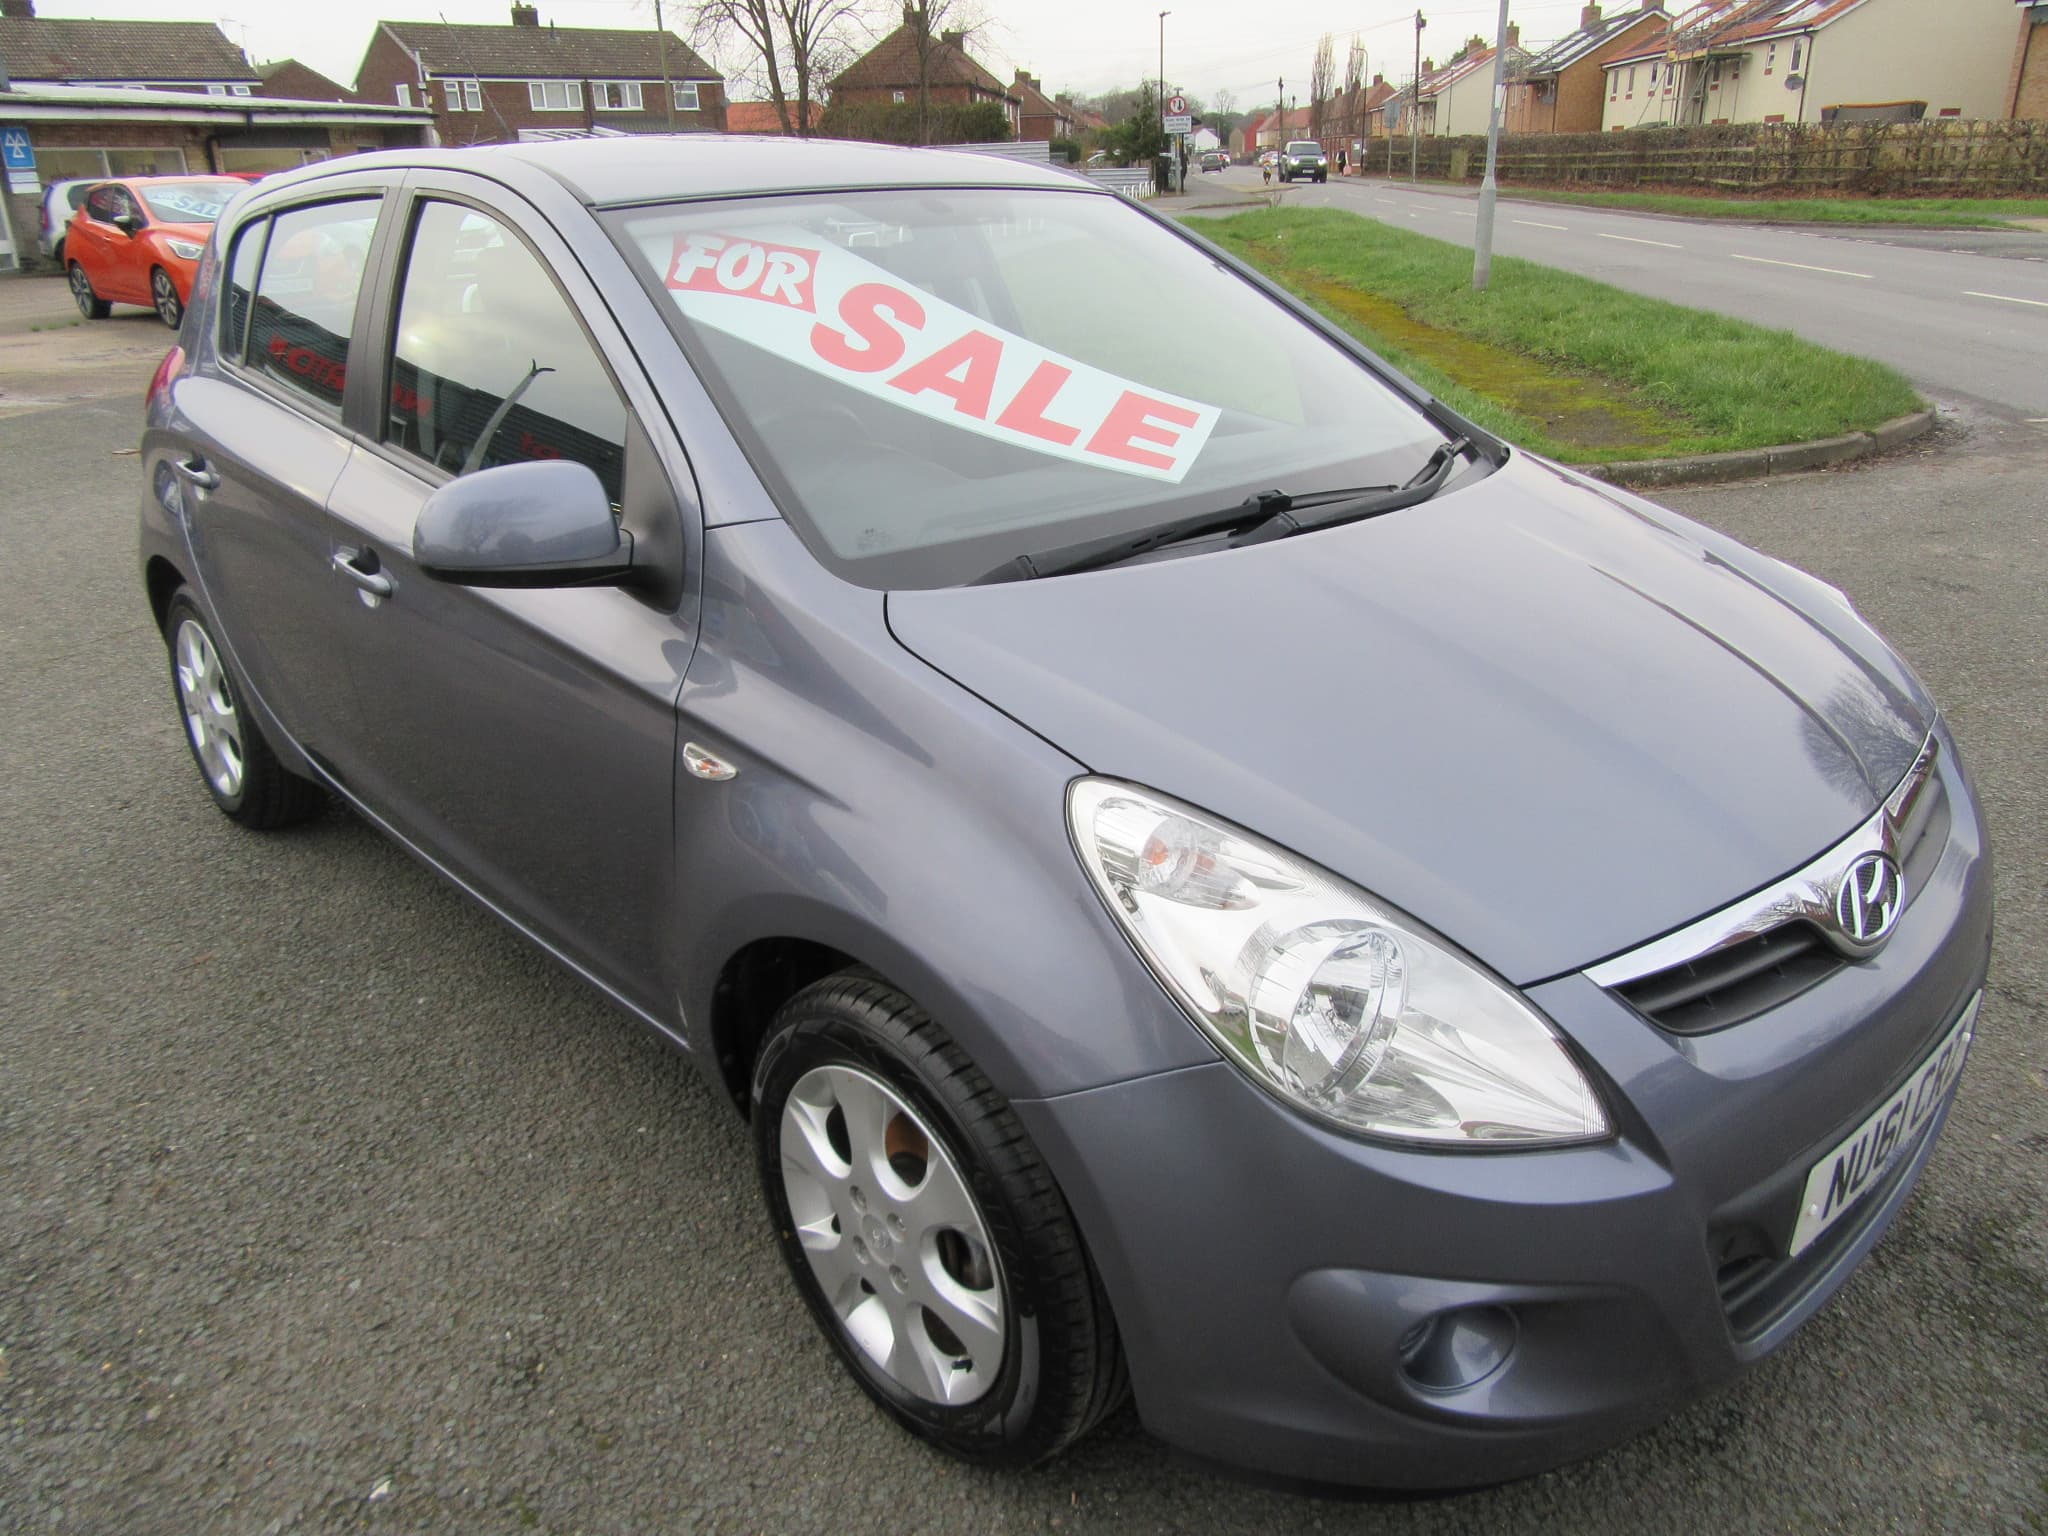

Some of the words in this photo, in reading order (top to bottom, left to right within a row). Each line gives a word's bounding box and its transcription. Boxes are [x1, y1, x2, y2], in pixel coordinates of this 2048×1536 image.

[175, 196, 218, 215] SAL
[672, 235, 811, 305] FOR
[810, 282, 1201, 470] SALE
[1821, 1087, 1914, 1220] NU61
